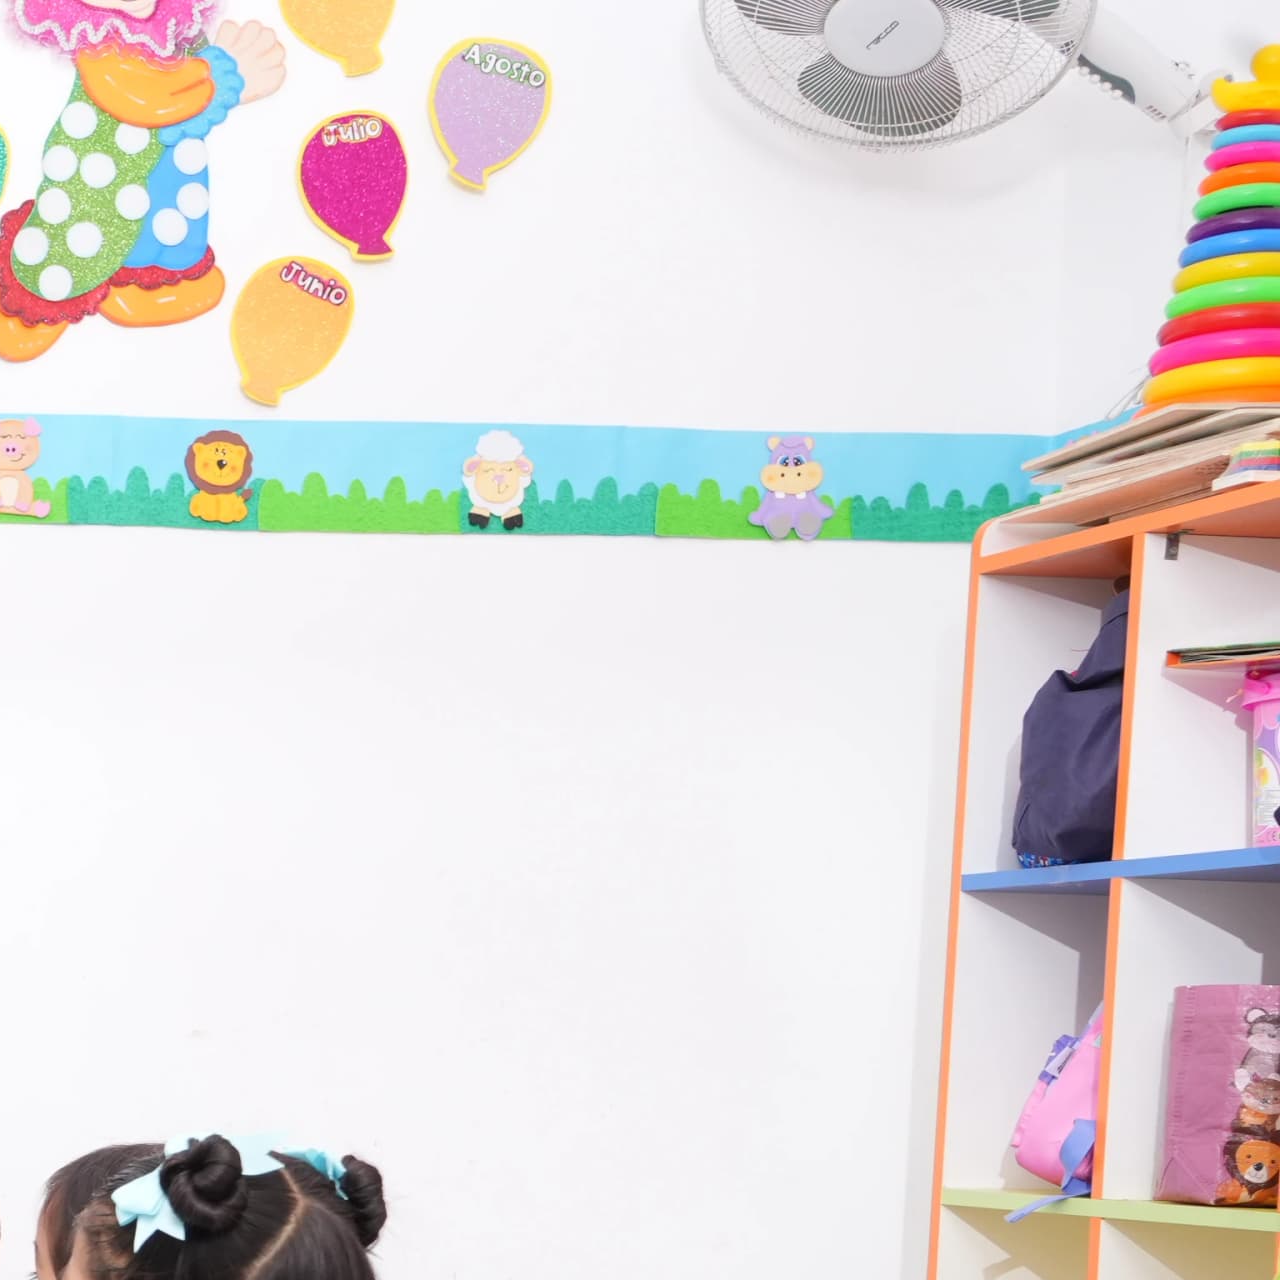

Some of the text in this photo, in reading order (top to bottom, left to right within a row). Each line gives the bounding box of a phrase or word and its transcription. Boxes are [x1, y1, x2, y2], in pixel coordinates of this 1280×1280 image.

[463, 43, 546, 88] Agosto
[322, 117, 382, 146] Julio
[280, 260, 347, 305] Junio
